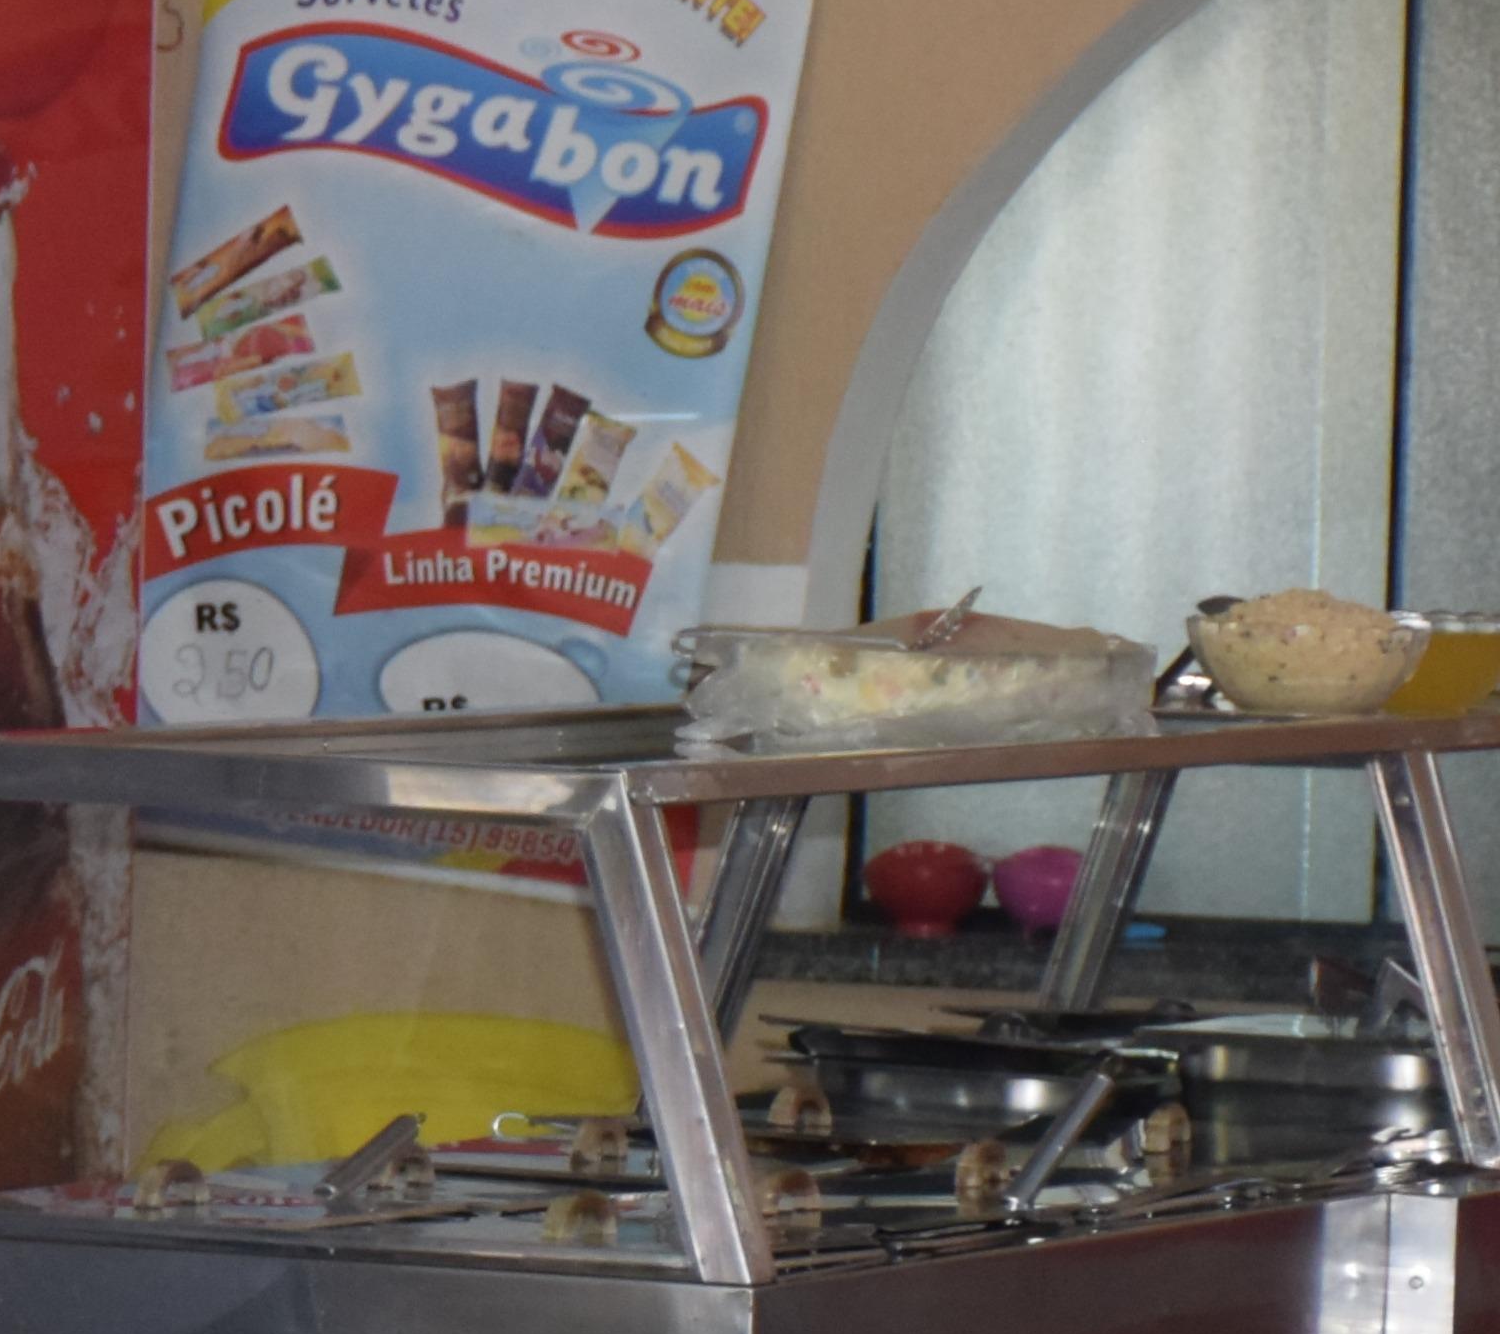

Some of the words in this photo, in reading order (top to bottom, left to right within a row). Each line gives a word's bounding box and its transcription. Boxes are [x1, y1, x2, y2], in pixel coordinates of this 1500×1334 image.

[266, 42, 725, 212] Gygabon
[157, 472, 339, 560] Picolé
[383, 550, 476, 587] Linha
[485, 548, 640, 611] Premium
[194, 602, 242, 633] R$
